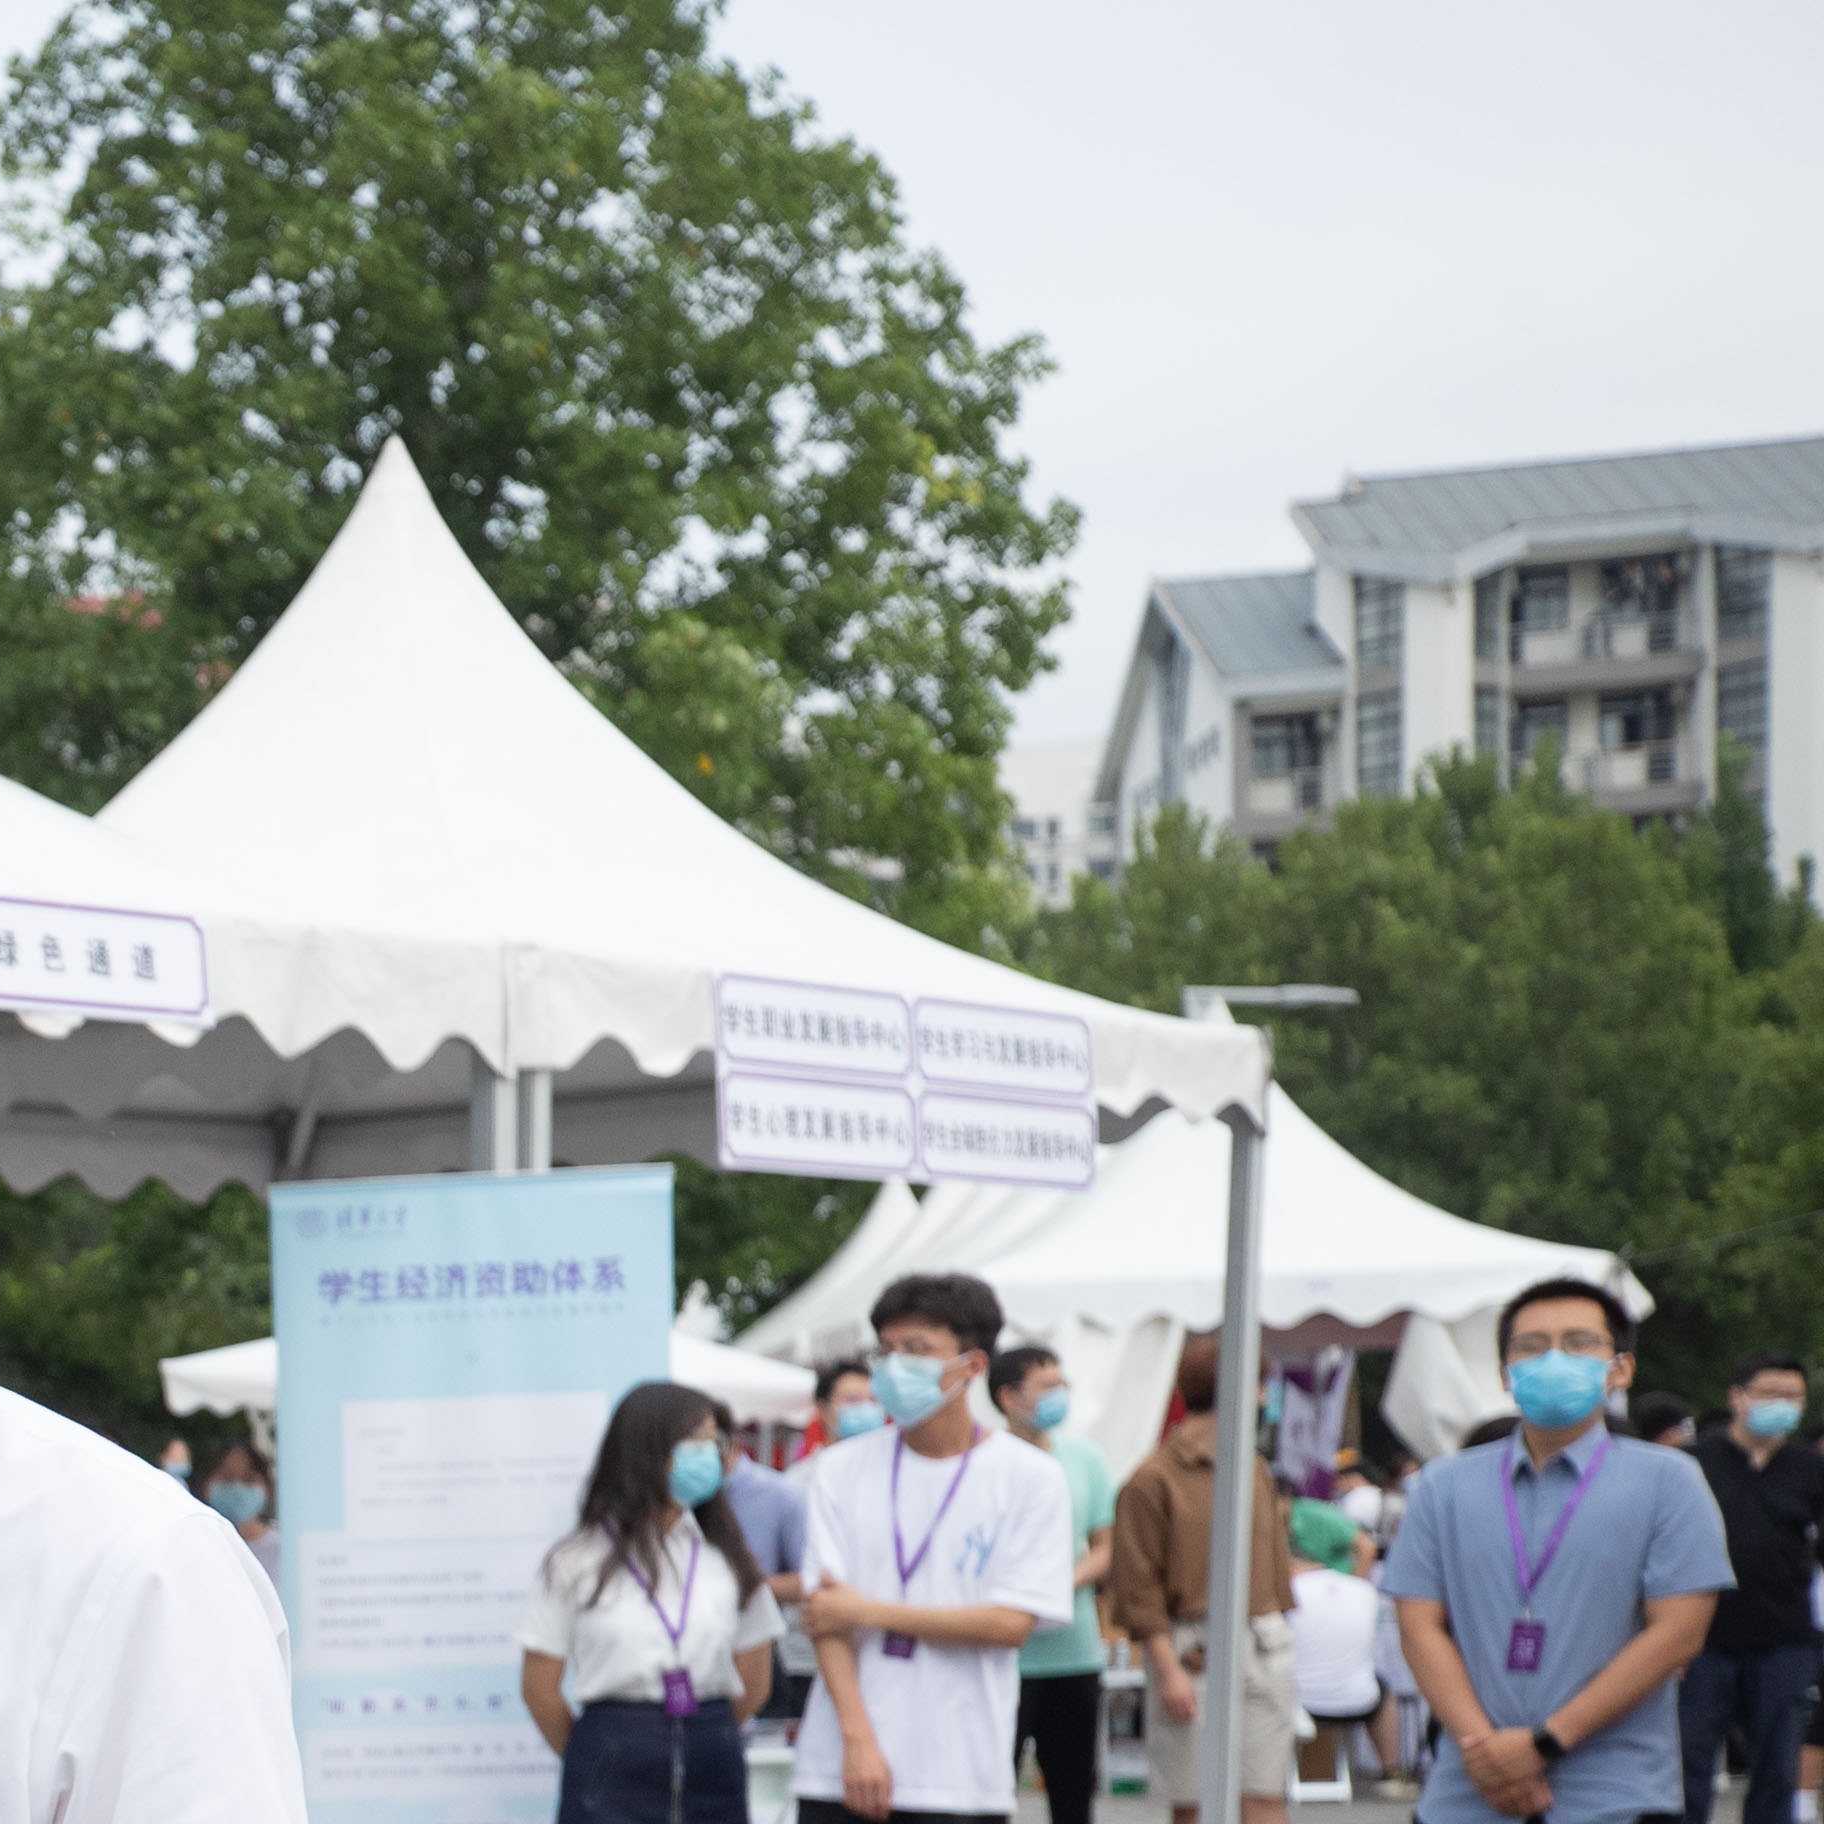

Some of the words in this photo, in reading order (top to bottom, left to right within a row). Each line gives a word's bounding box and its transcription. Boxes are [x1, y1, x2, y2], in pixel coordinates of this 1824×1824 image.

[317, 1255, 627, 1306] 学生经济资助体系
